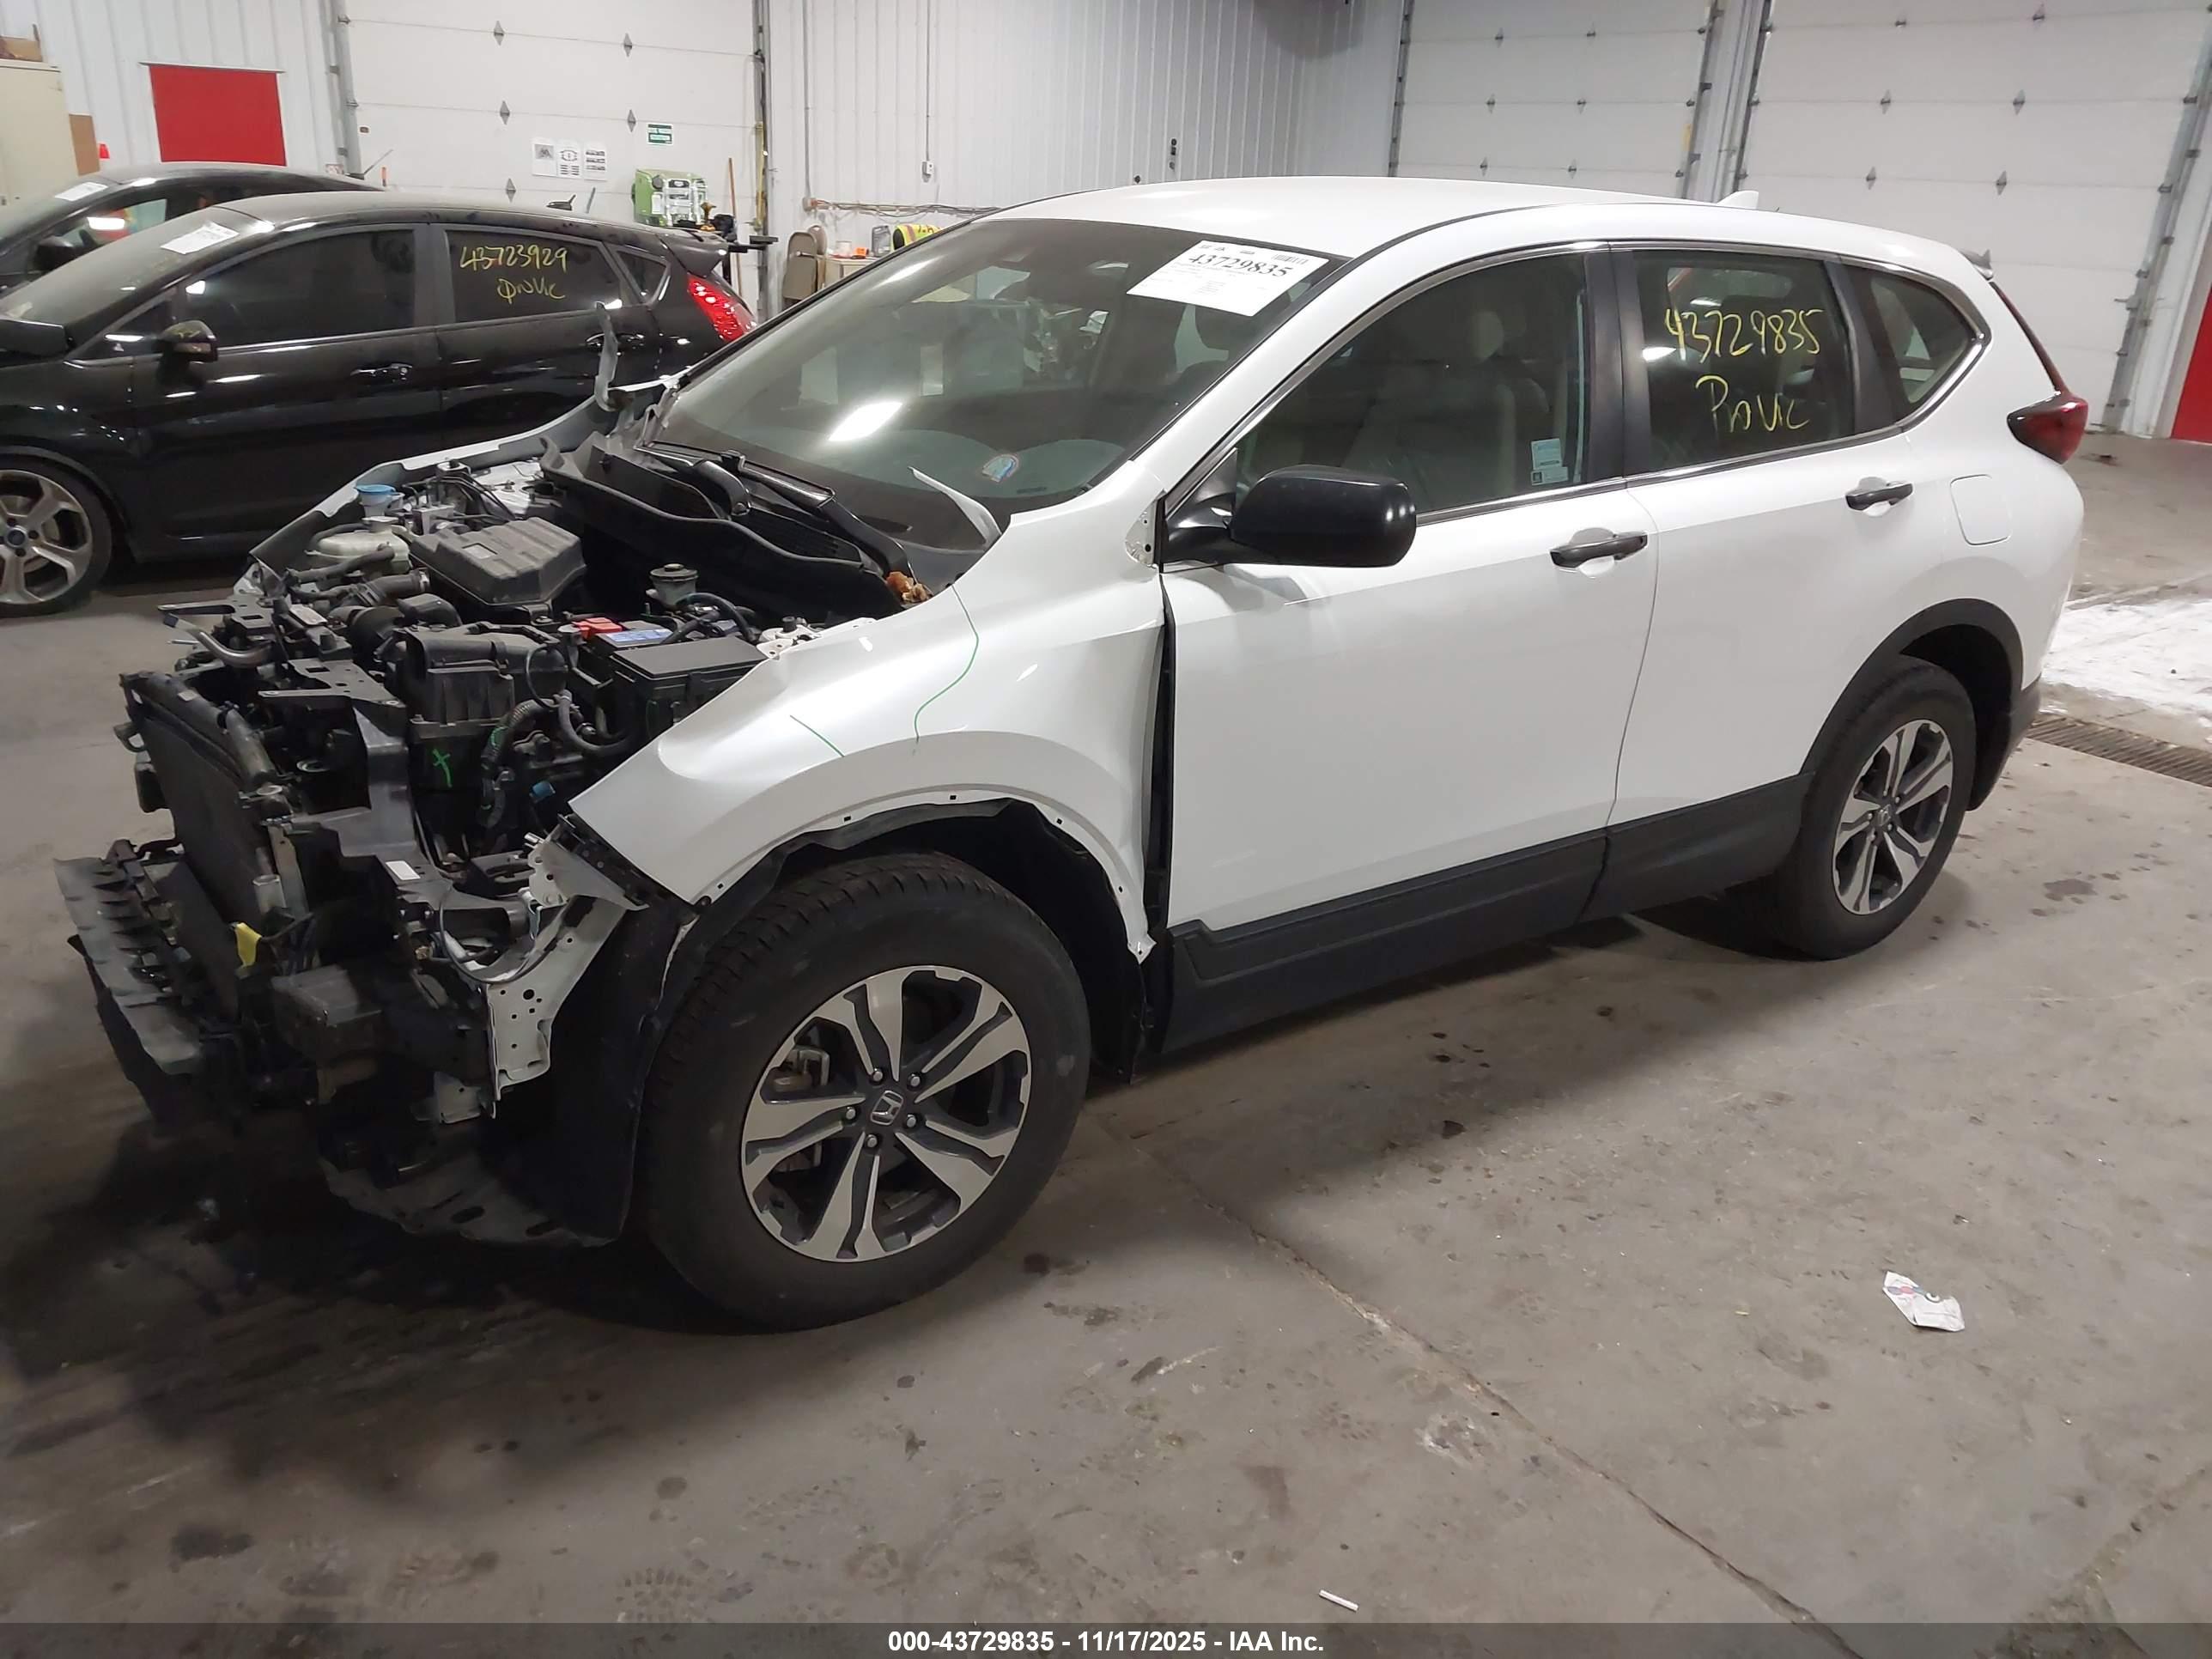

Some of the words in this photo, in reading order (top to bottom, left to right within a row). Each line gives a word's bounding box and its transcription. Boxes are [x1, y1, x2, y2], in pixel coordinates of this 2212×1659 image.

[459, 244, 568, 273] 43723929
[1188, 253, 1294, 277] 43729835
[1664, 307, 1824, 364] 43729835
